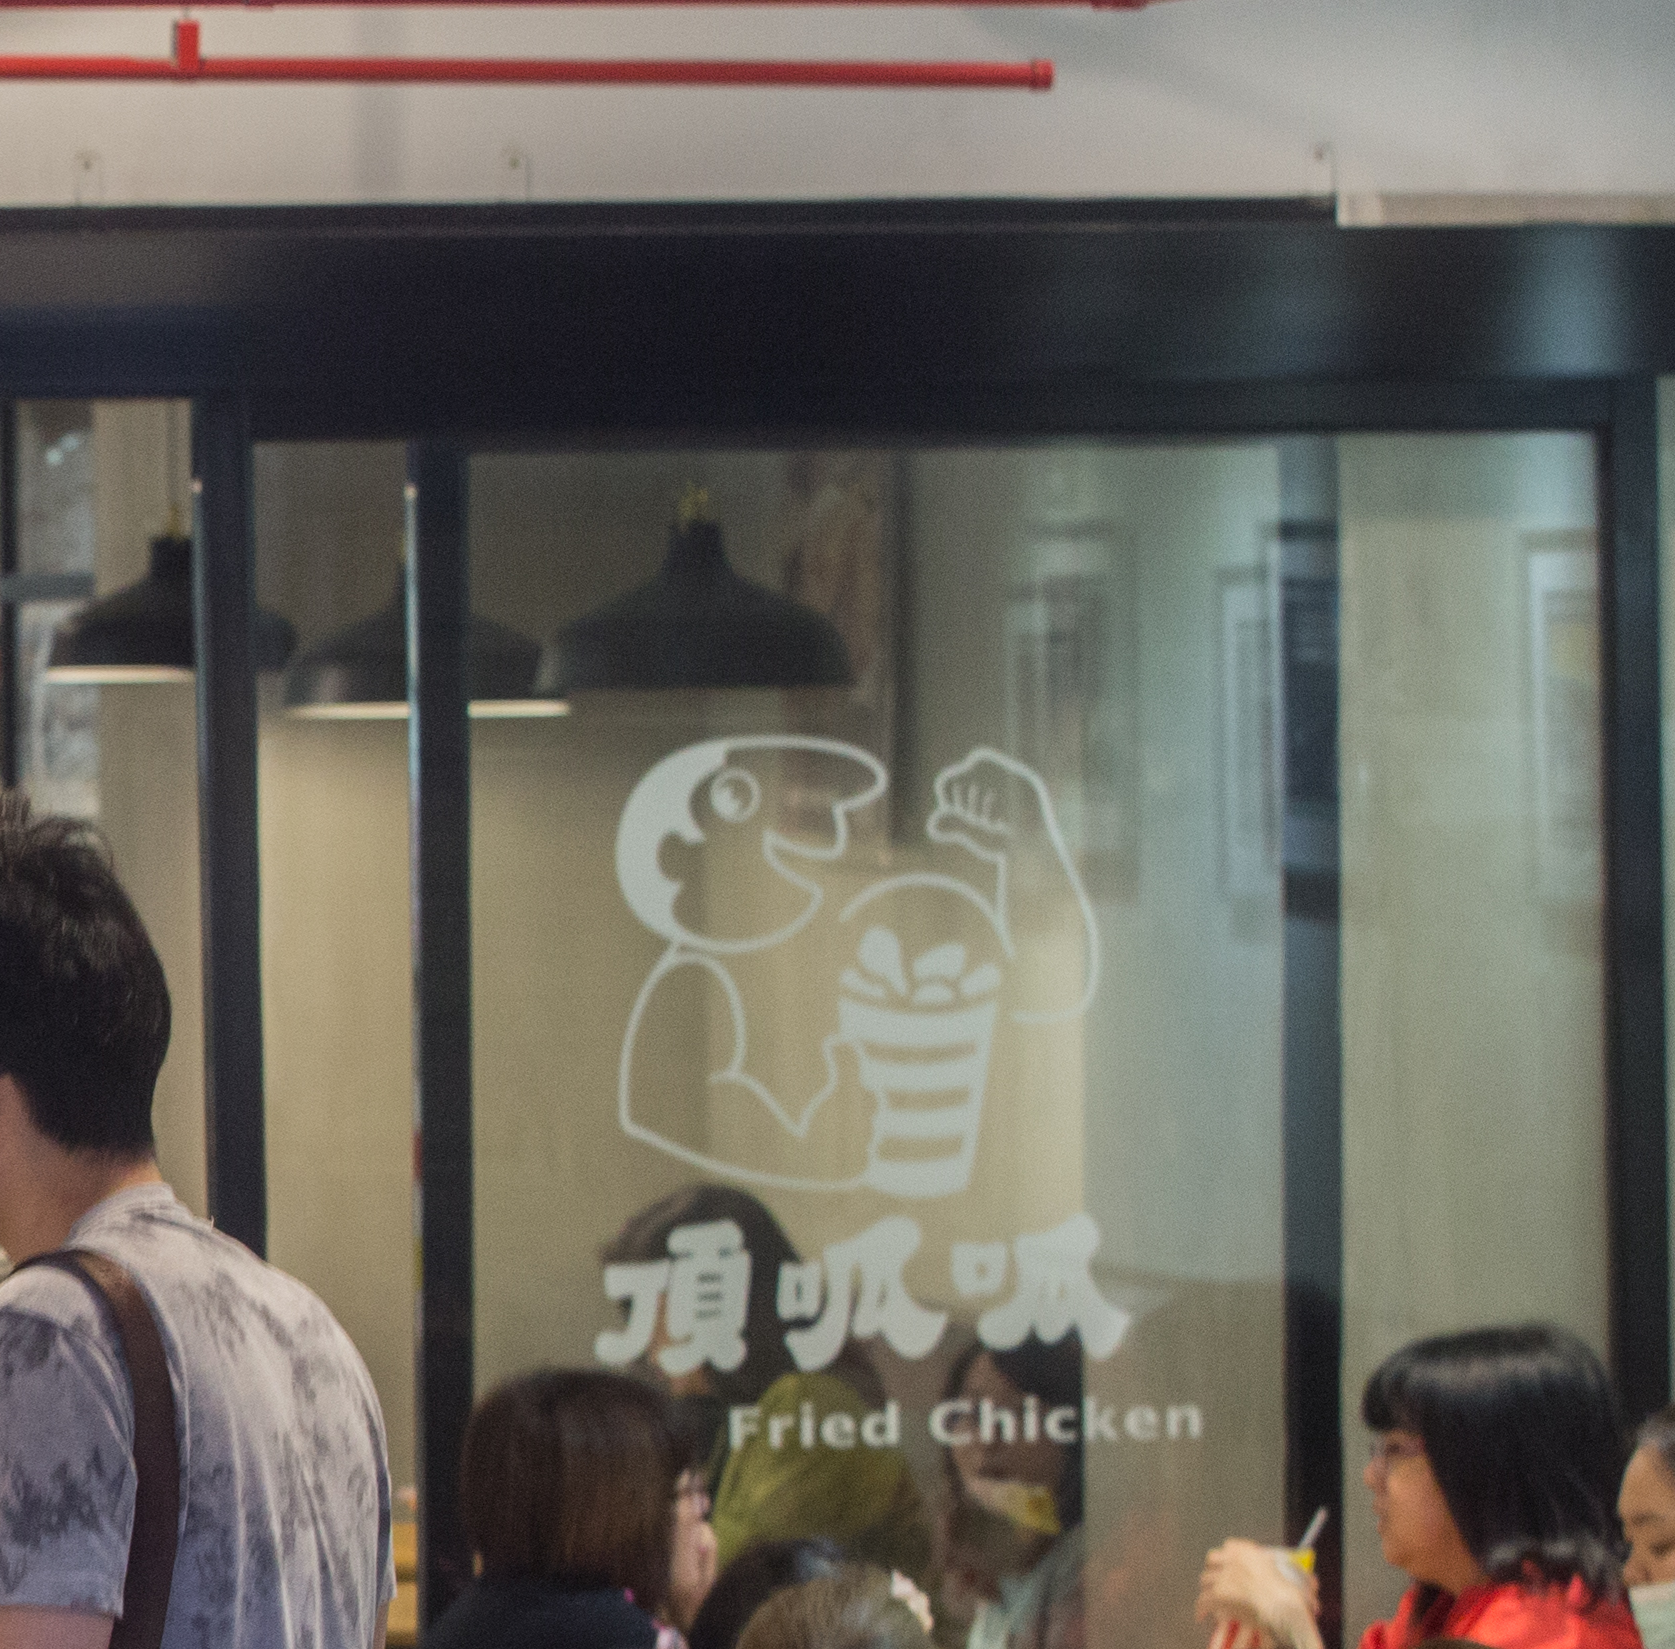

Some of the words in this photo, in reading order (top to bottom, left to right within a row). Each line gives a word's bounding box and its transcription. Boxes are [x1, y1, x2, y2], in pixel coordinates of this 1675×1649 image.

[593, 1212, 1132, 1374] 頂呱呱
[727, 1401, 900, 1451] Fried
[927, 1397, 1205, 1445] Chicken
